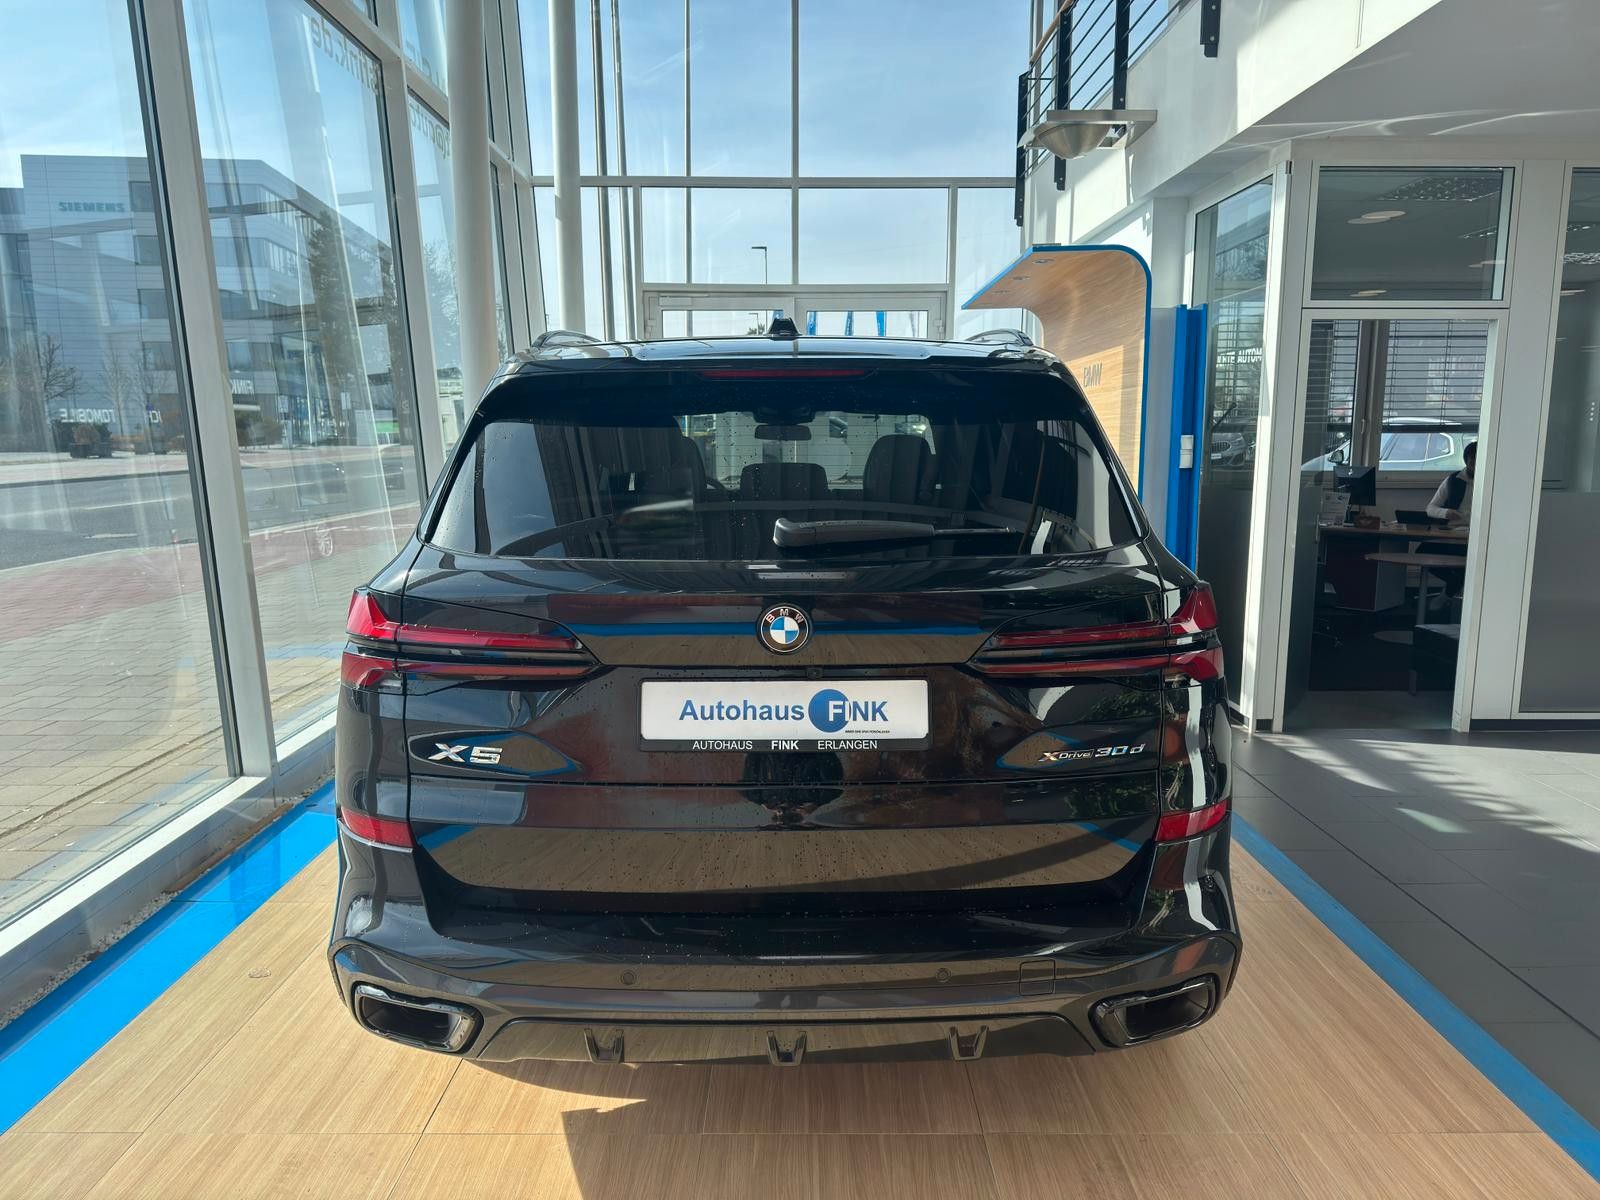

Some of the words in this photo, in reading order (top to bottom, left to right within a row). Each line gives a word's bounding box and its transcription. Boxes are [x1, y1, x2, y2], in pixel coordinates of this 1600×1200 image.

[58, 202, 125, 213] SIEMENS
[765, 608, 804, 624] BMW
[678, 699, 805, 721] Autohaus
[828, 700, 889, 722] FINK
[692, 740, 753, 750] AUTOHAUS
[771, 740, 799, 750] FINK
[817, 740, 878, 750] ERLANGEN
[428, 743, 503, 765] X5
